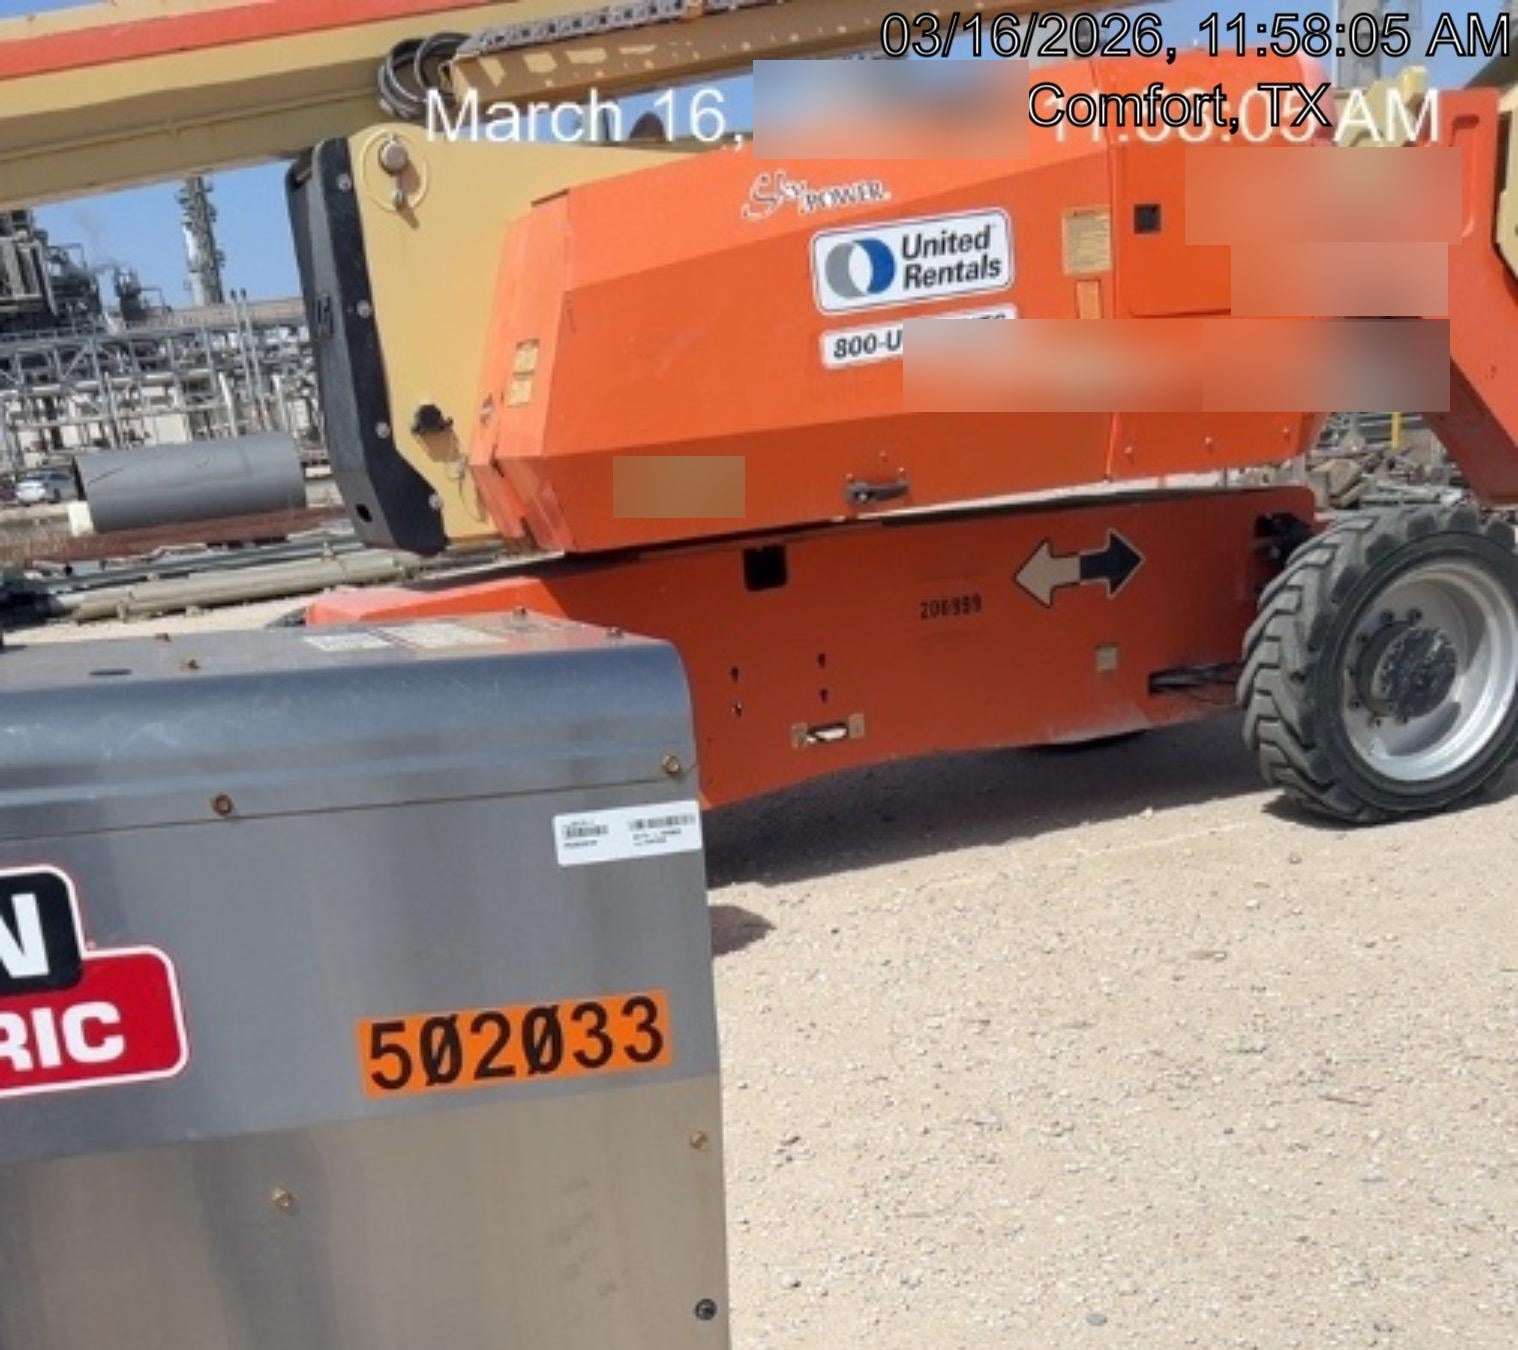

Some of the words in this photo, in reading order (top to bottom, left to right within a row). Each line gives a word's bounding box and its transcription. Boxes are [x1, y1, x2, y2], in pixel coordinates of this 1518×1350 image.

[902, 224, 992, 260] United
[903, 255, 1002, 289] Rentals
[371, 996, 663, 1090] 502033
